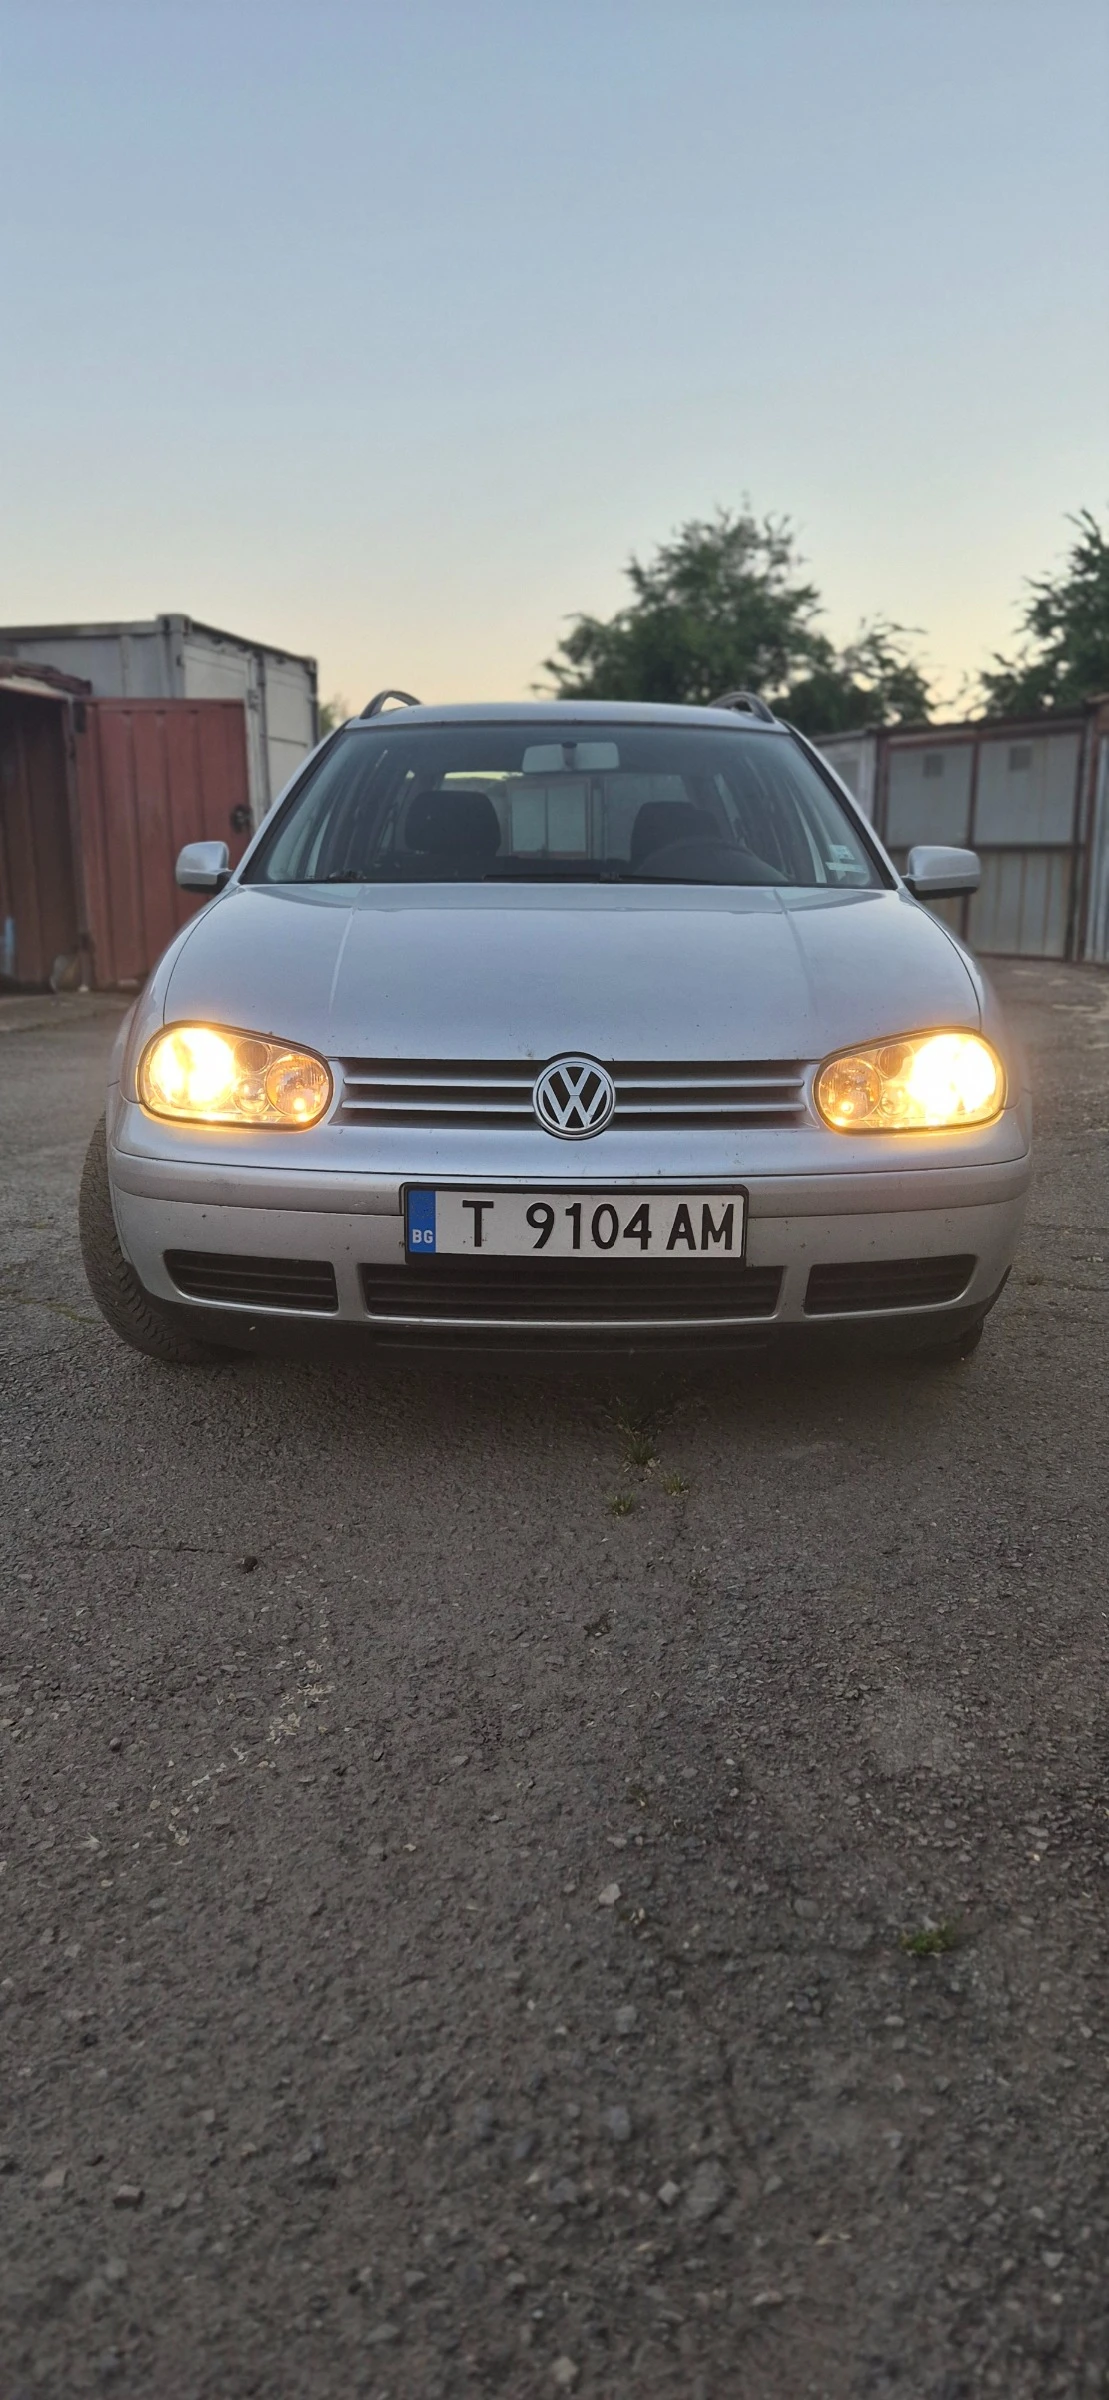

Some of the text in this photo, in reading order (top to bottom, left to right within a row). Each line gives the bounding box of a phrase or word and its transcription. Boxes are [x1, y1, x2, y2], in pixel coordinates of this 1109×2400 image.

[539, 1063, 610, 1131] VW
[412, 1229, 434, 1244] BG
[462, 1200, 735, 1251] T 9104 AM
